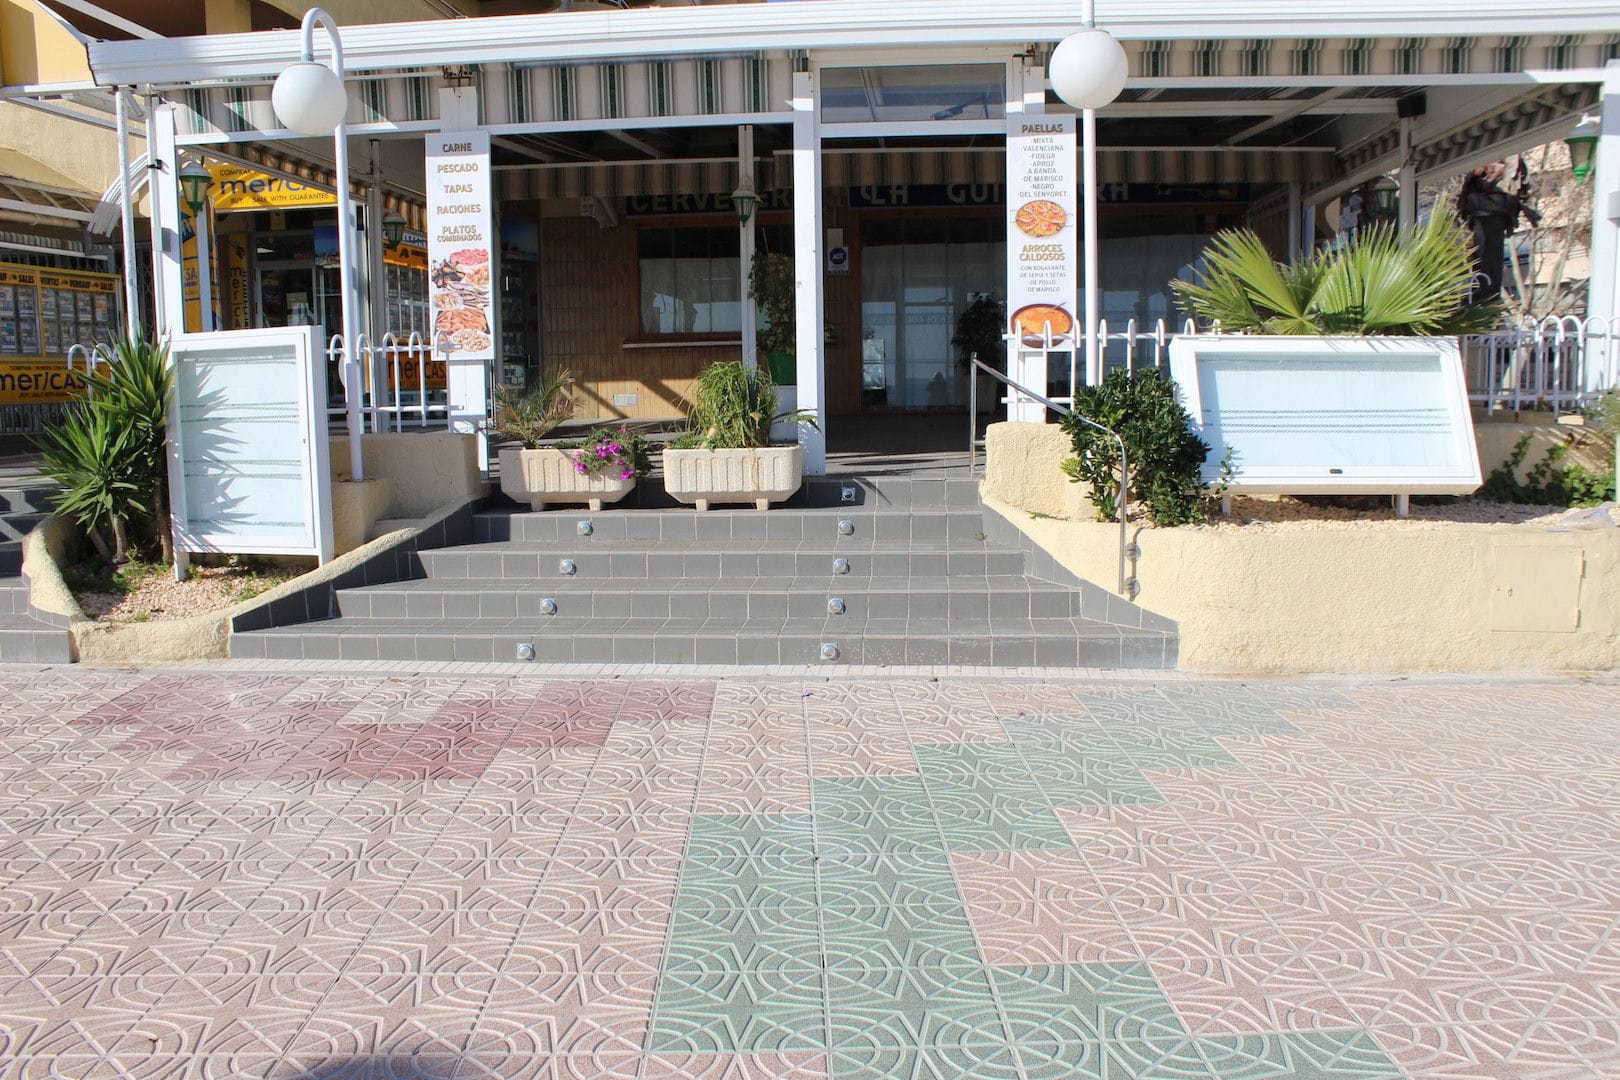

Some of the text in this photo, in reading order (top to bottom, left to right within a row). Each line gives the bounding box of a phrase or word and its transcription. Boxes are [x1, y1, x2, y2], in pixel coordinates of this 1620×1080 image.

[1022, 123, 1064, 133] PAELLAS
[442, 142, 472, 152] CARNE
[437, 163, 479, 173] PESCADO
[444, 184, 473, 193] TAPAS
[289, 192, 329, 201] GUARANTEE
[436, 204, 481, 214] RACIONES
[442, 225, 477, 234] PLATOS
[437, 233, 482, 243] COMBINADOS
[1022, 244, 1063, 252] ARROCES
[1019, 252, 1066, 261] CALDOSOS
